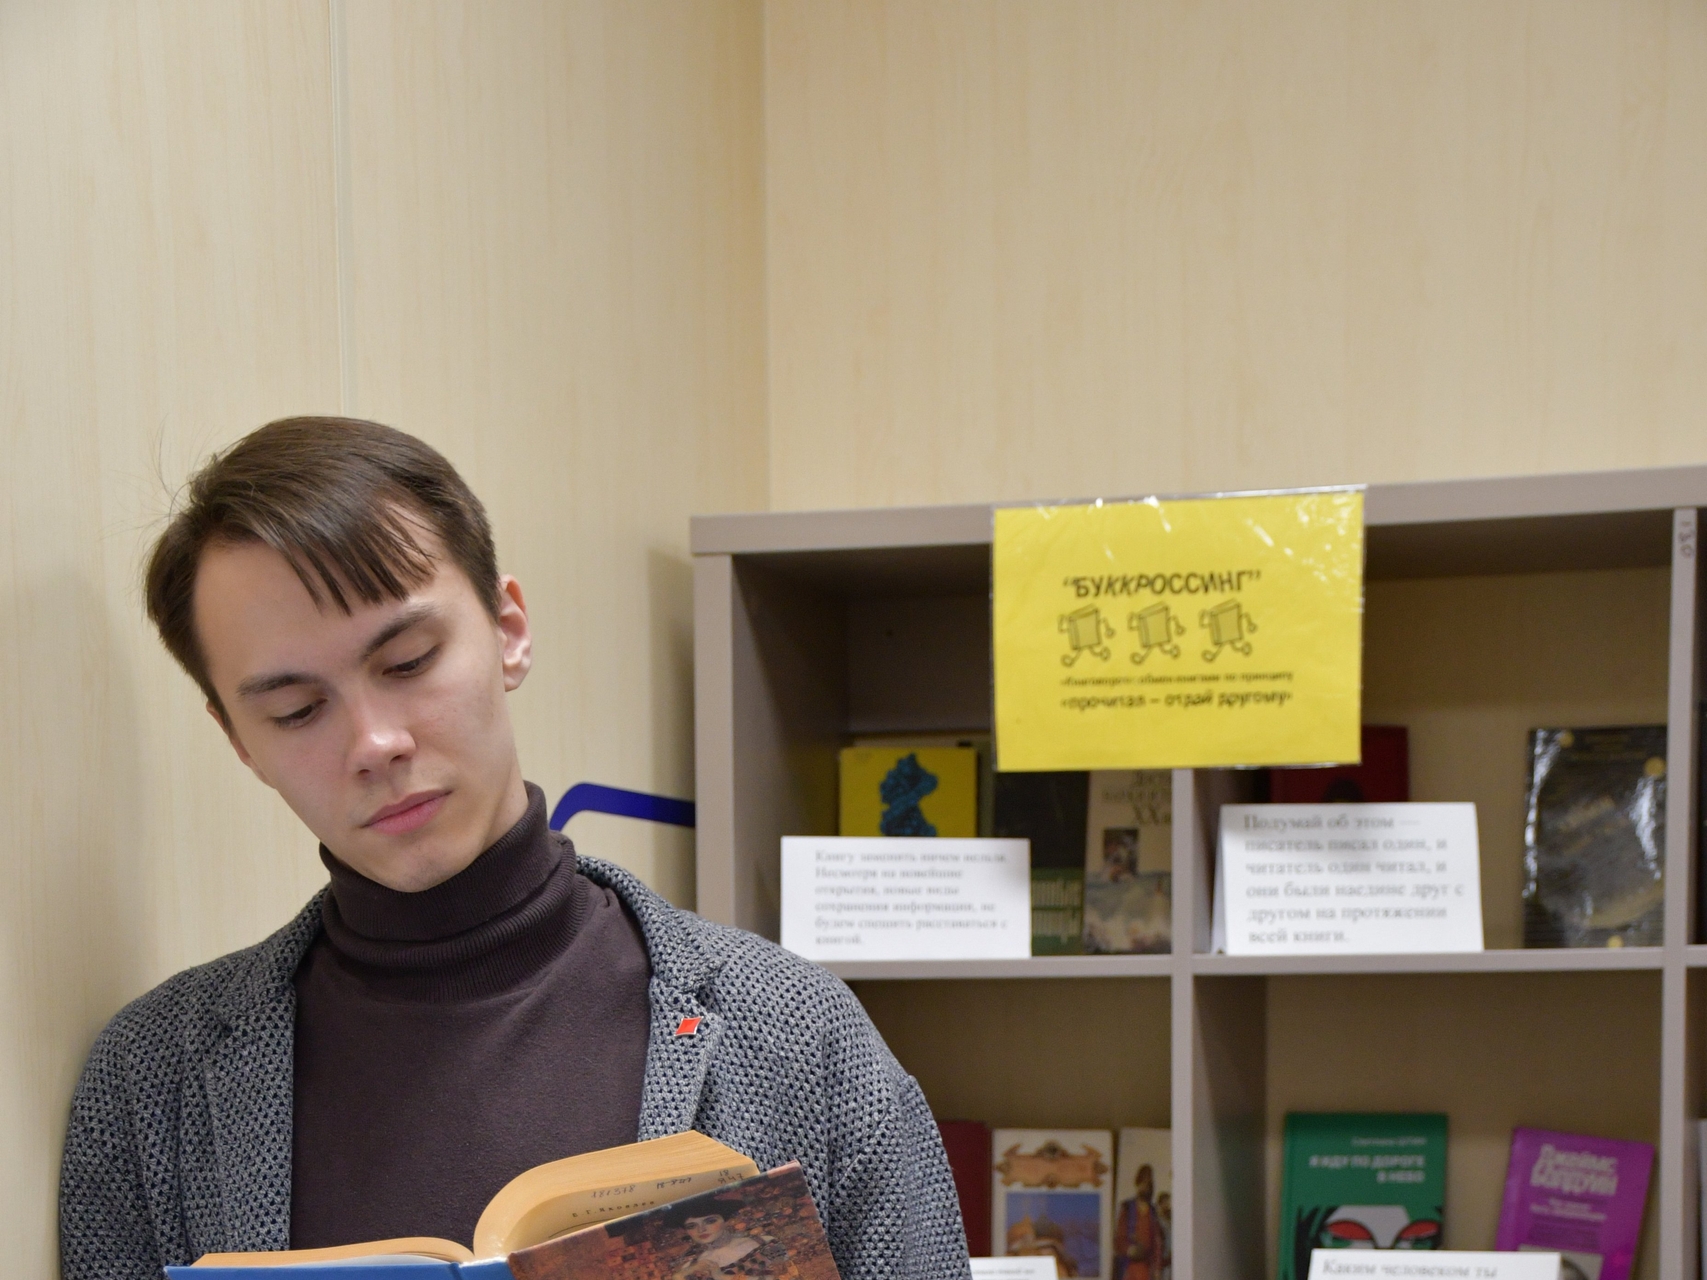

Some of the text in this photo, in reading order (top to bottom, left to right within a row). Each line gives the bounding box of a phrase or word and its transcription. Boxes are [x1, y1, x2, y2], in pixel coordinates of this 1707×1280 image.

[1244, 813, 1323, 832] Подумай
[1327, 814, 1350, 829] об
[1355, 815, 1395, 829] этом
[1245, 838, 1448, 853] писатель писал один, и
[1245, 861, 1448, 875] читатель один читал, и
[1246, 881, 1464, 899] они были наедине друг с
[1247, 906, 1448, 923] другом на протяжении
[1249, 927, 1288, 943] всей
[1322, 1259, 1497, 1279] Каким человеком ты
